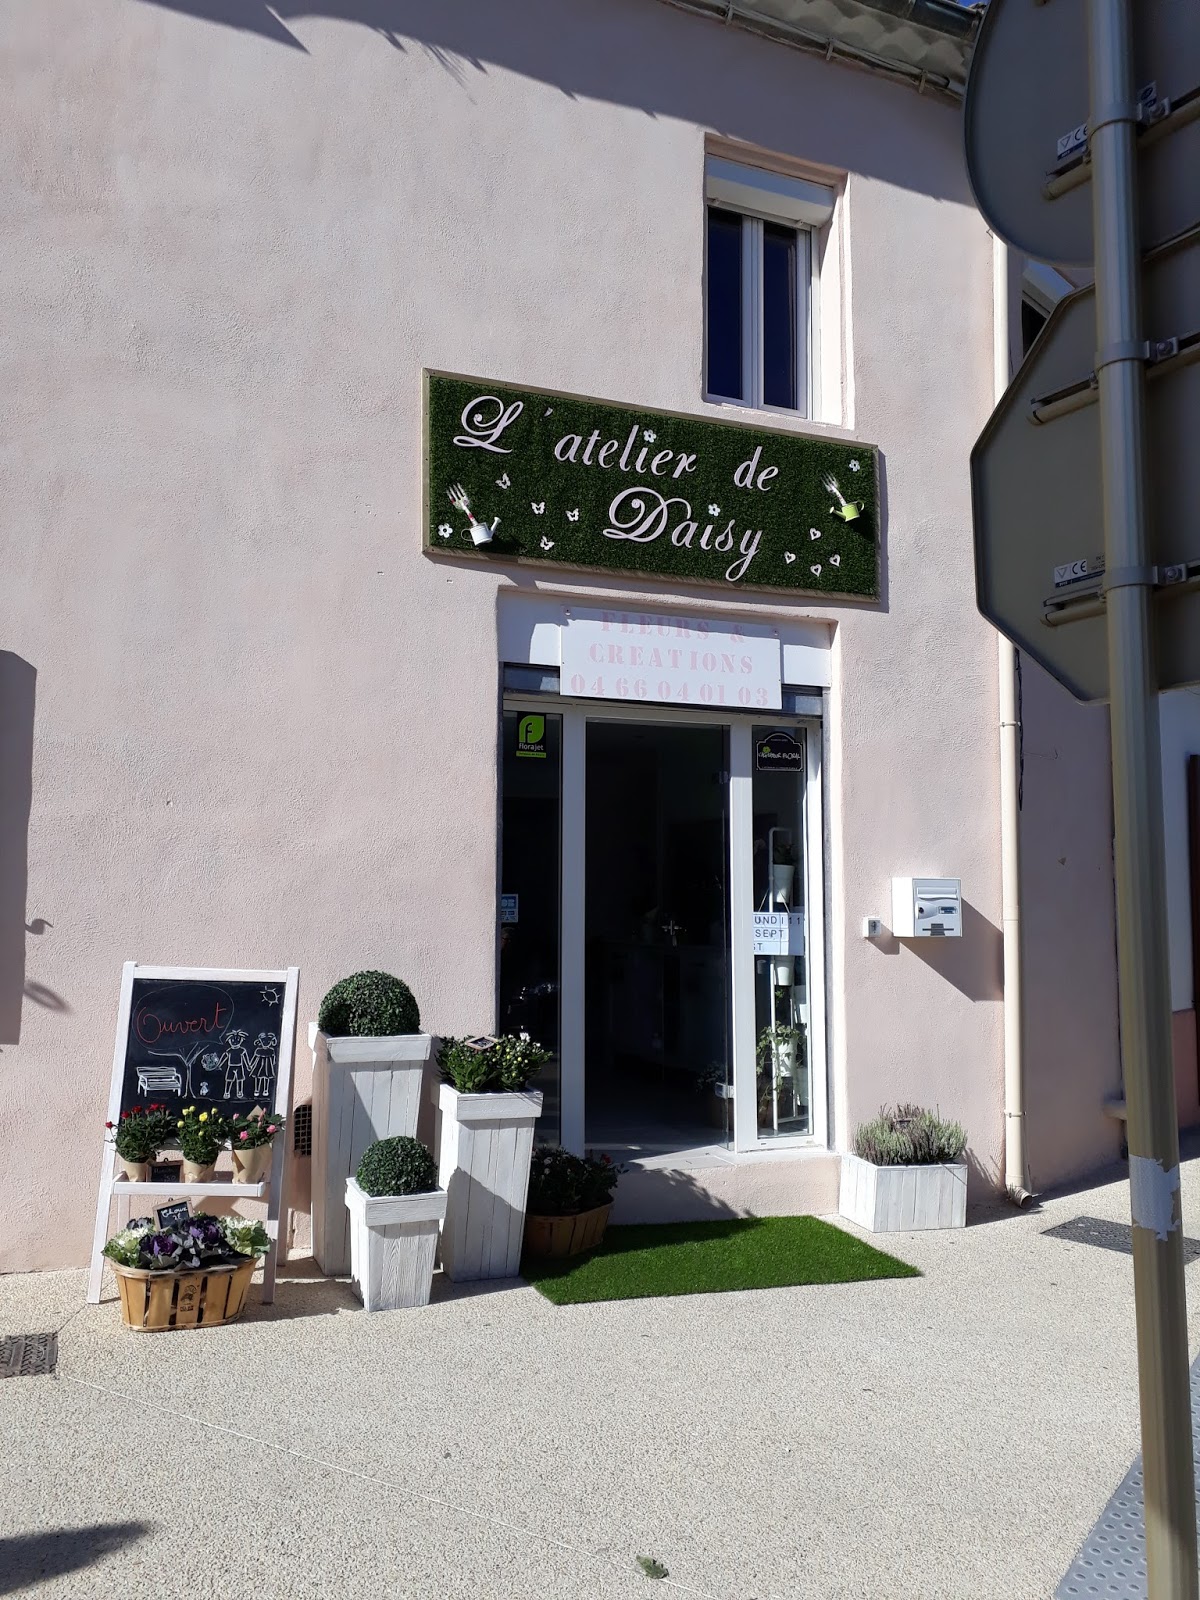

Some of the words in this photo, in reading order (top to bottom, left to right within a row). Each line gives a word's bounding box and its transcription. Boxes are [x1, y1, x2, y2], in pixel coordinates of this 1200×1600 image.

[733, 445, 780, 492] de
[602, 486, 764, 582] Daisy
[600, 610, 710, 641] FLEURS
[729, 623, 746, 644] &
[588, 642, 754, 675] CREATIONS
[570, 672, 606, 697] 04
[615, 676, 649, 699] 66
[657, 680, 690, 702] 04
[699, 683, 726, 704] 01
[738, 686, 770, 708] 03
[518, 743, 545, 752] florajet
[755, 929, 785, 938] SEPT
[136, 1002, 228, 1044] Ouvert
